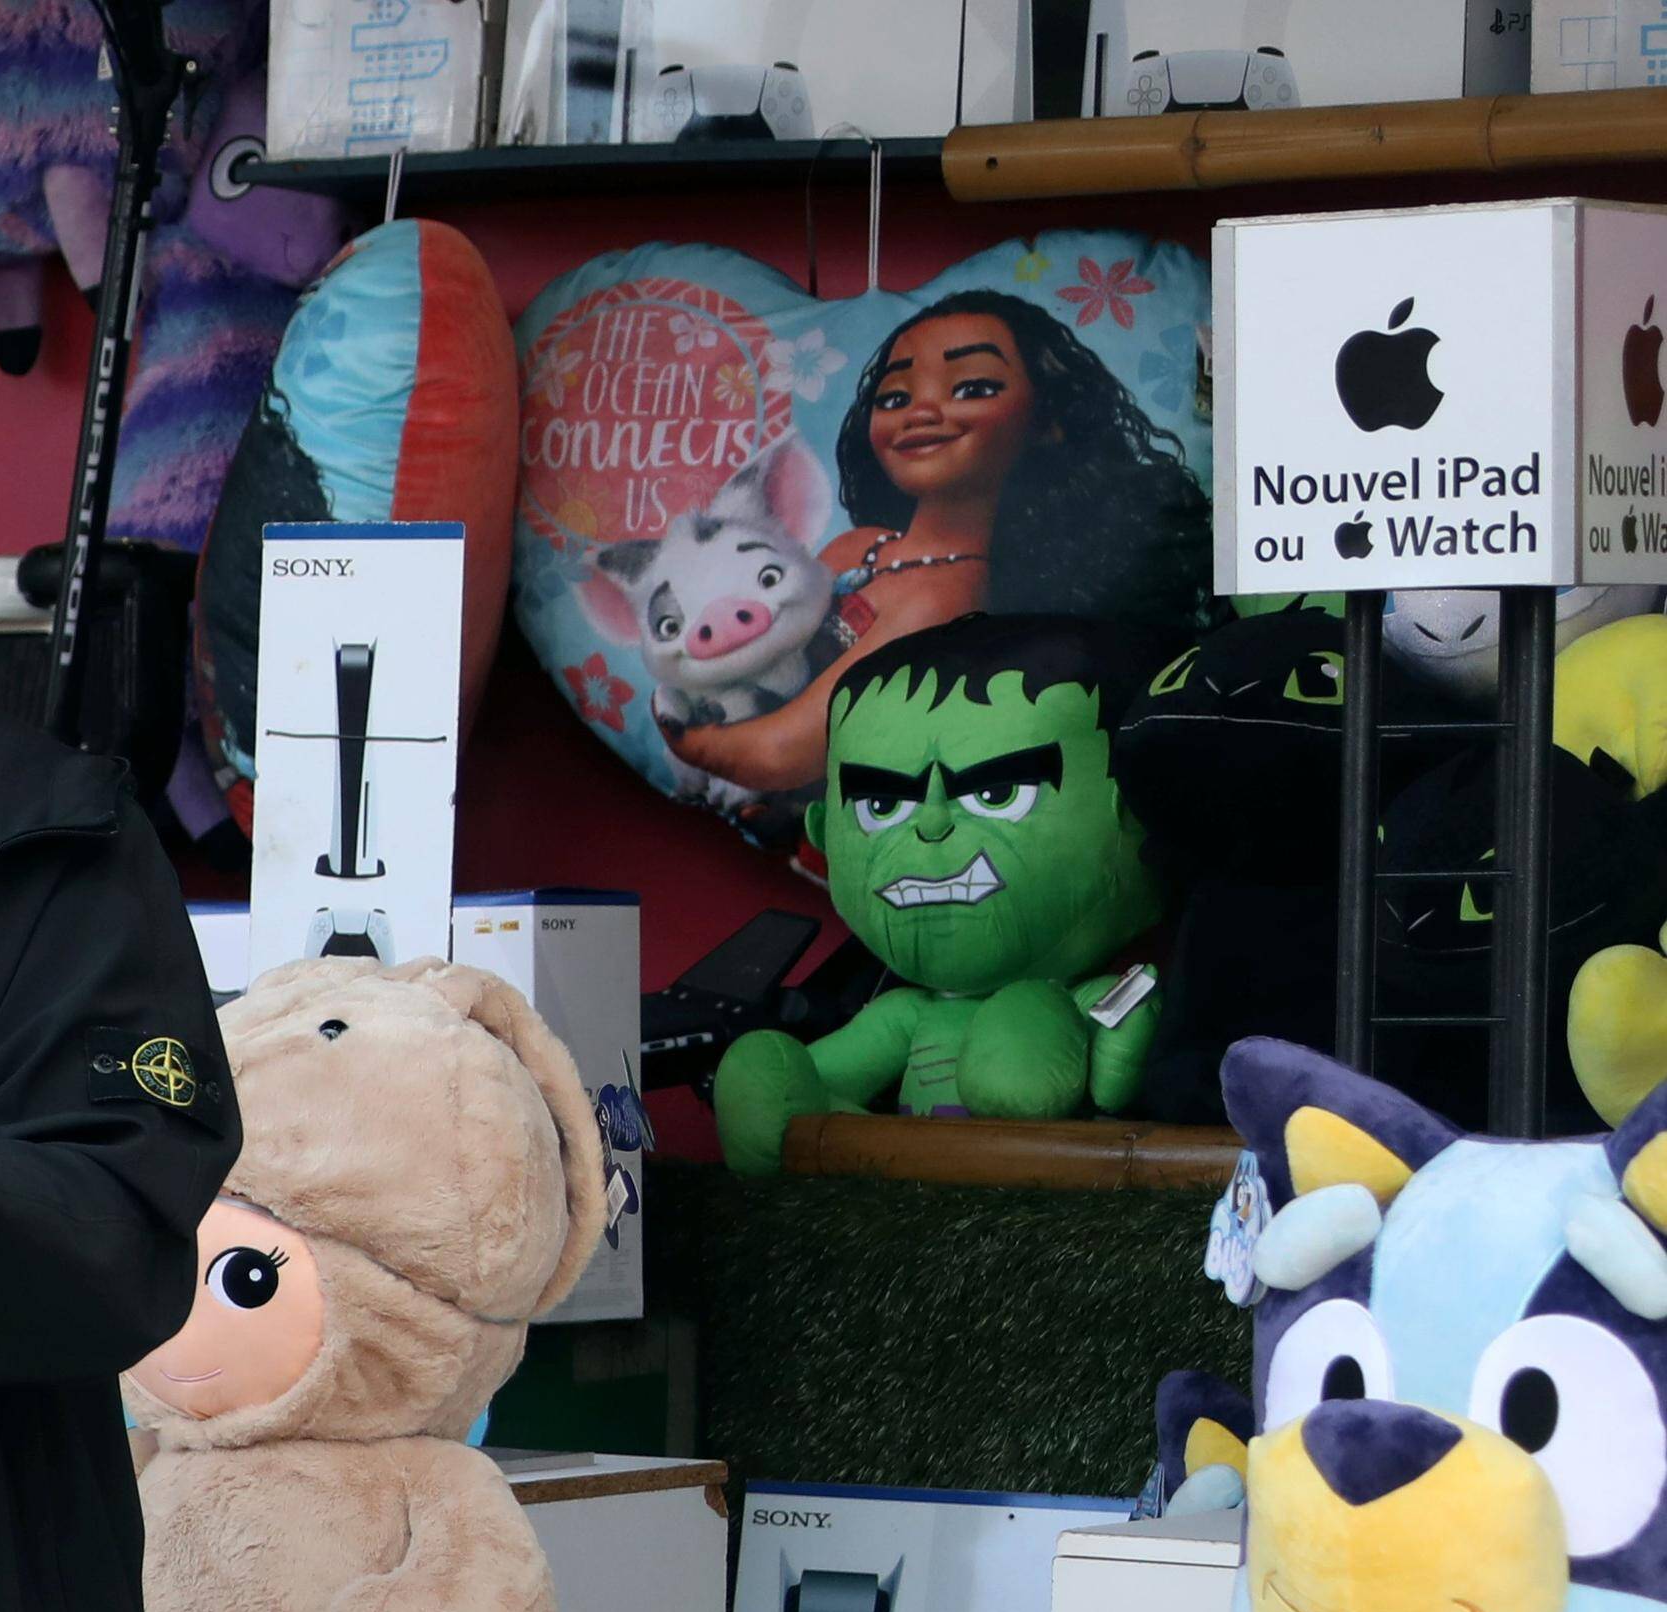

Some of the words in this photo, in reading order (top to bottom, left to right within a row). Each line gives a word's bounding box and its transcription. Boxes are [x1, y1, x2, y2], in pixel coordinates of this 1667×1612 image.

[588, 310, 659, 363] THE
[583, 363, 707, 417] OCEAN
[1253, 458, 1421, 507] Nouvel
[1437, 452, 1541, 498] iPad
[1589, 453, 1655, 497] Nouvel
[624, 479, 668, 533] US
[1254, 531, 1305, 562] ou
[1386, 510, 1538, 558] Watch
[1589, 526, 1610, 553] ou
[272, 558, 354, 578] SONY
[541, 918, 577, 931] SONY
[752, 1509, 832, 1529] SONY
